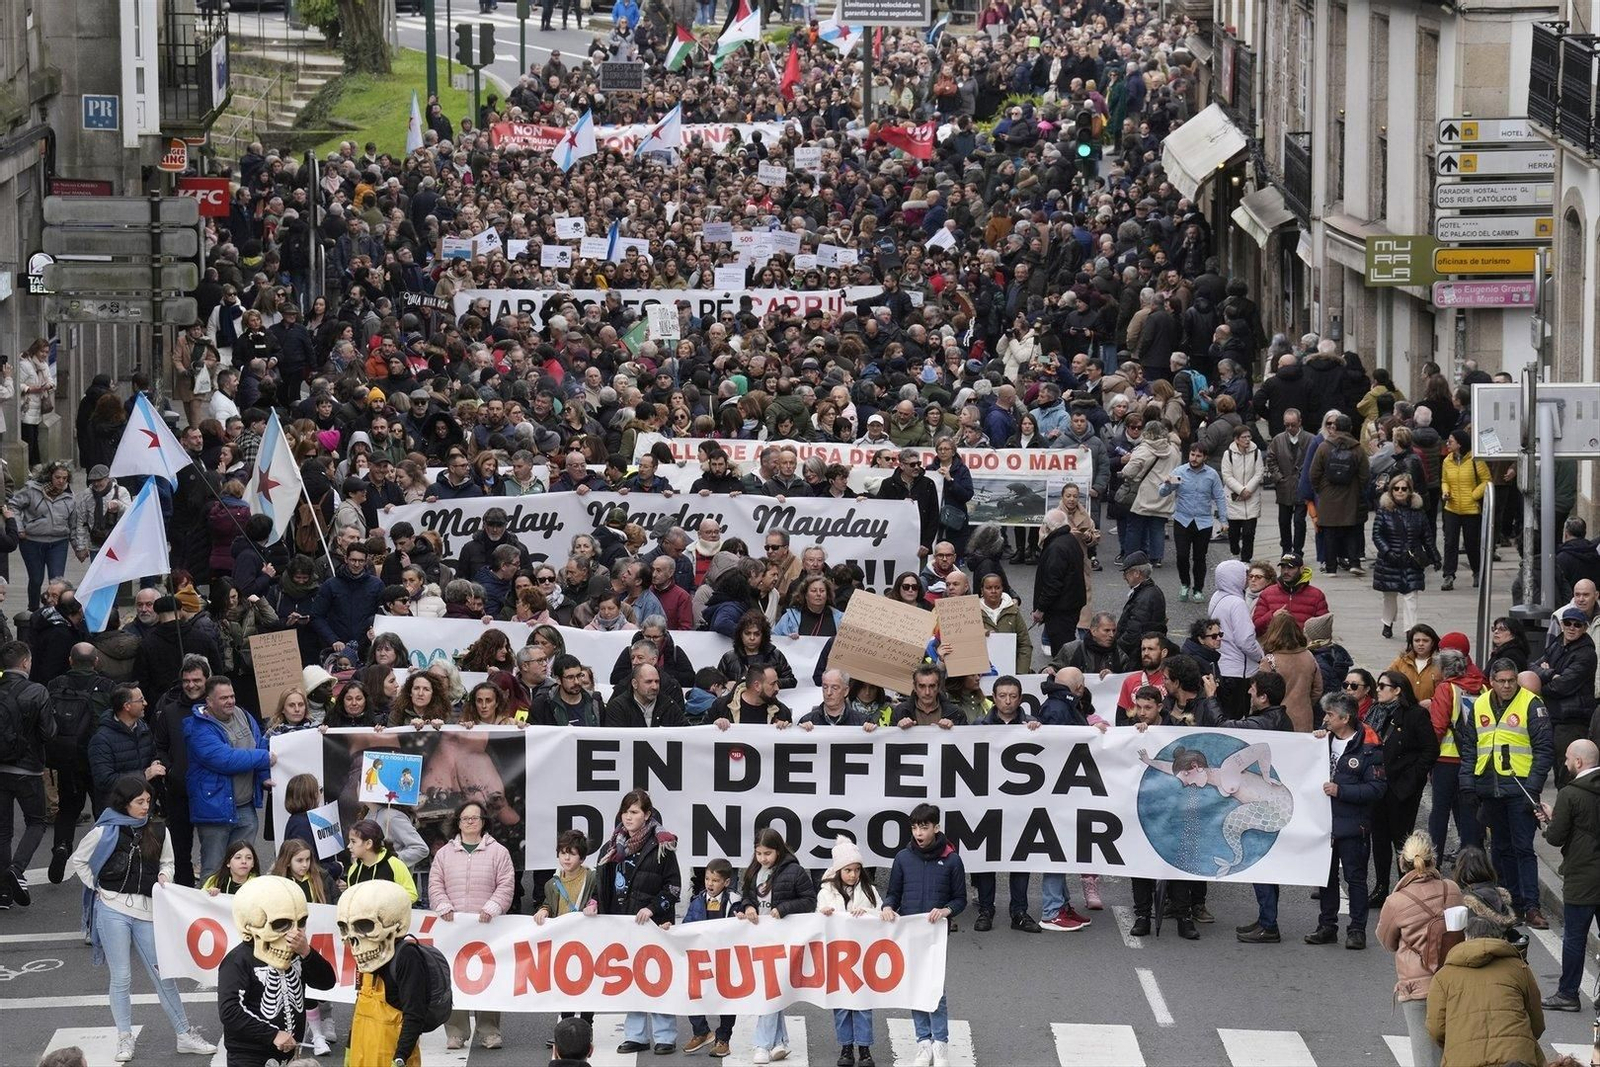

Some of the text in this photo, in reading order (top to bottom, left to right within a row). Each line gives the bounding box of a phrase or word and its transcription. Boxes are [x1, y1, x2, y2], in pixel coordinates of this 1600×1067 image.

[88, 100, 112, 118] PR
[513, 125, 543, 136] NON
[177, 190, 224, 205] KFC
[1477, 195, 1518, 203] CATÓLICOS
[1437, 257, 1511, 265] oficinas de turismo
[1464, 285, 1499, 295] Eugenio
[1501, 284, 1532, 294] Granell
[1476, 295, 1505, 303] Museo
[1006, 453, 1022, 470] O
[1029, 453, 1077, 471] MAR
[420, 503, 564, 539] Maday,
[753, 504, 890, 547] Mayday
[575, 739, 1109, 798] EN DEFENSA
[942, 808, 1124, 867] MAR
[186, 916, 229, 971] O
[452, 940, 497, 996] O
[513, 940, 674, 998] NOSO
[686, 938, 906, 1001] FUTURO
